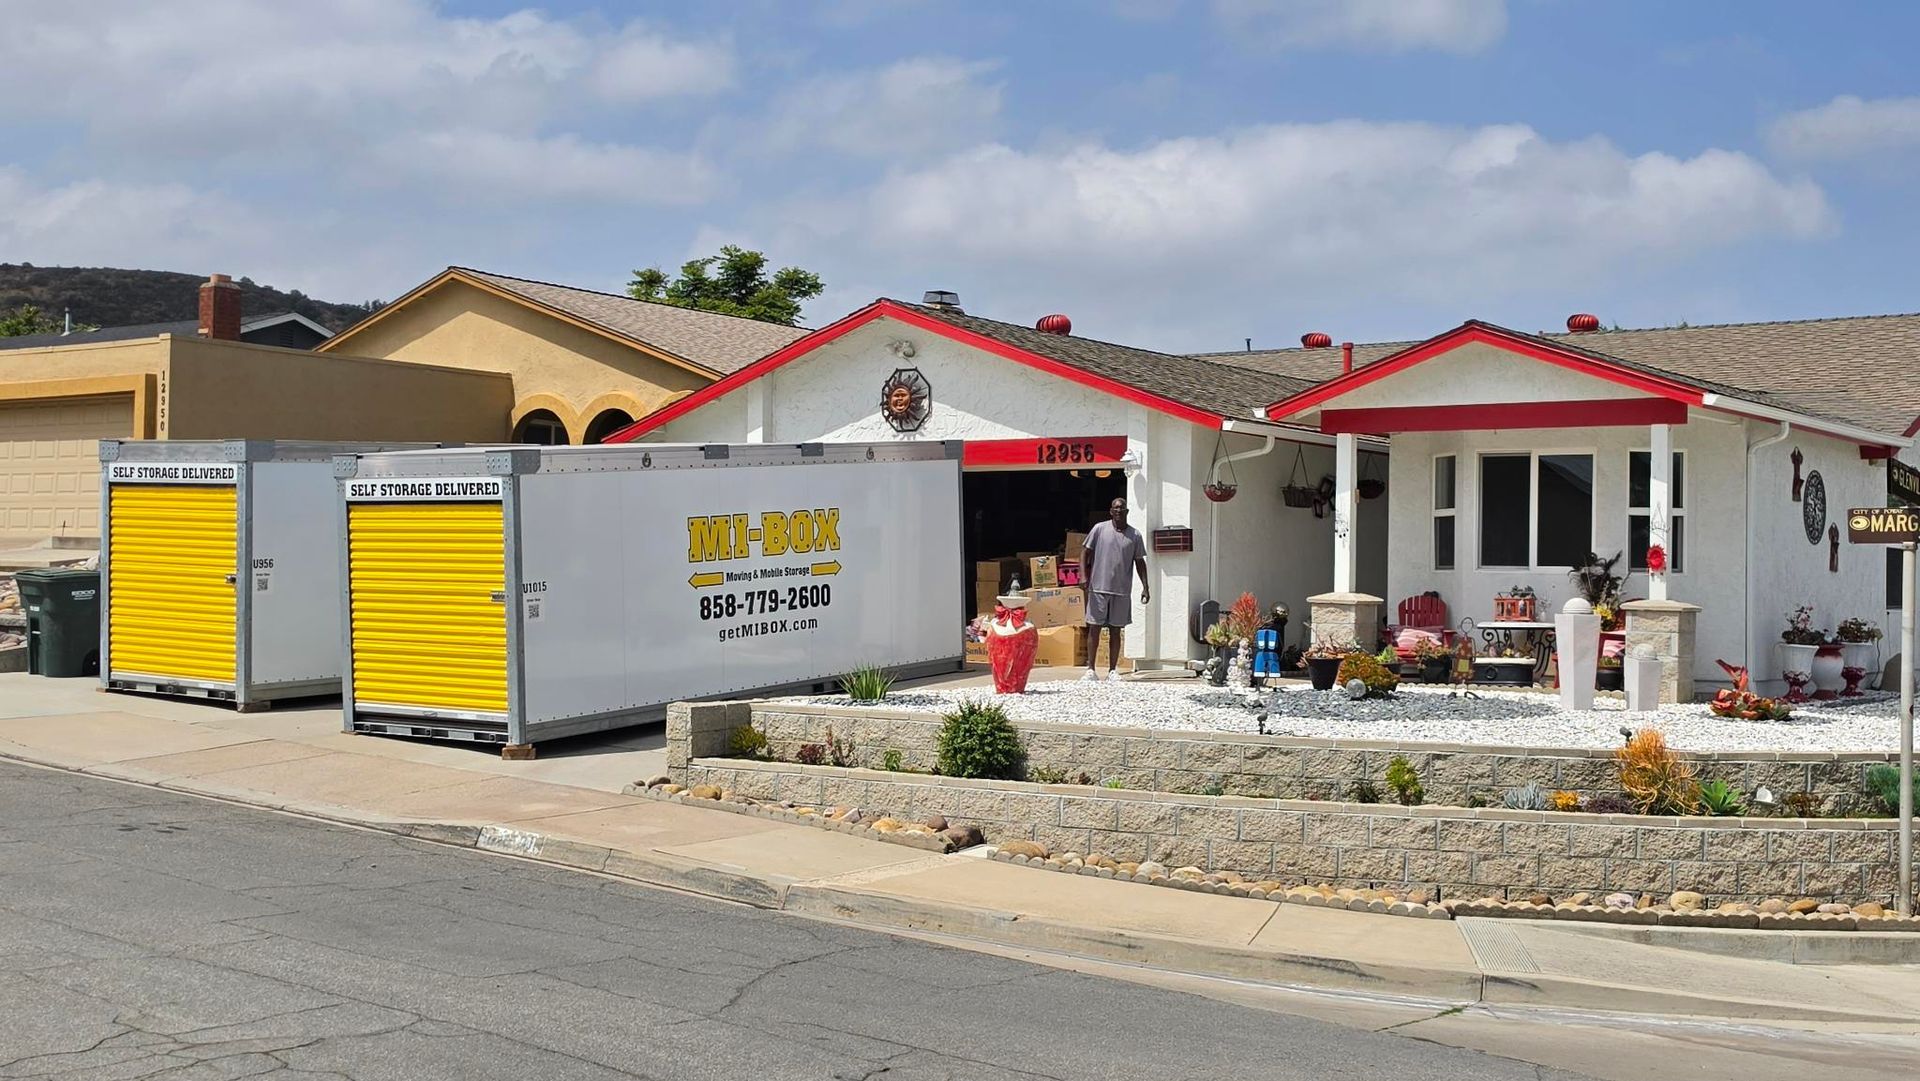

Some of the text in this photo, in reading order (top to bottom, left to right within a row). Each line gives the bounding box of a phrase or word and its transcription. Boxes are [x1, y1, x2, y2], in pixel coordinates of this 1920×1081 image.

[1037, 442, 1095, 464] 12956
[113, 466, 234, 479] SELF STORAGE DELIVERED
[350, 482, 500, 496] SELF STORAGE DELIVERED
[1870, 514, 1920, 532] MARG
[687, 507, 841, 563] MI-BOX
[253, 558, 274, 569] U956
[726, 566, 810, 582] Moving & Mobile Storage
[522, 581, 547, 593] U1015
[700, 583, 831, 621] 858-779-2600
[719, 618, 818, 642] getMIBOX.com
